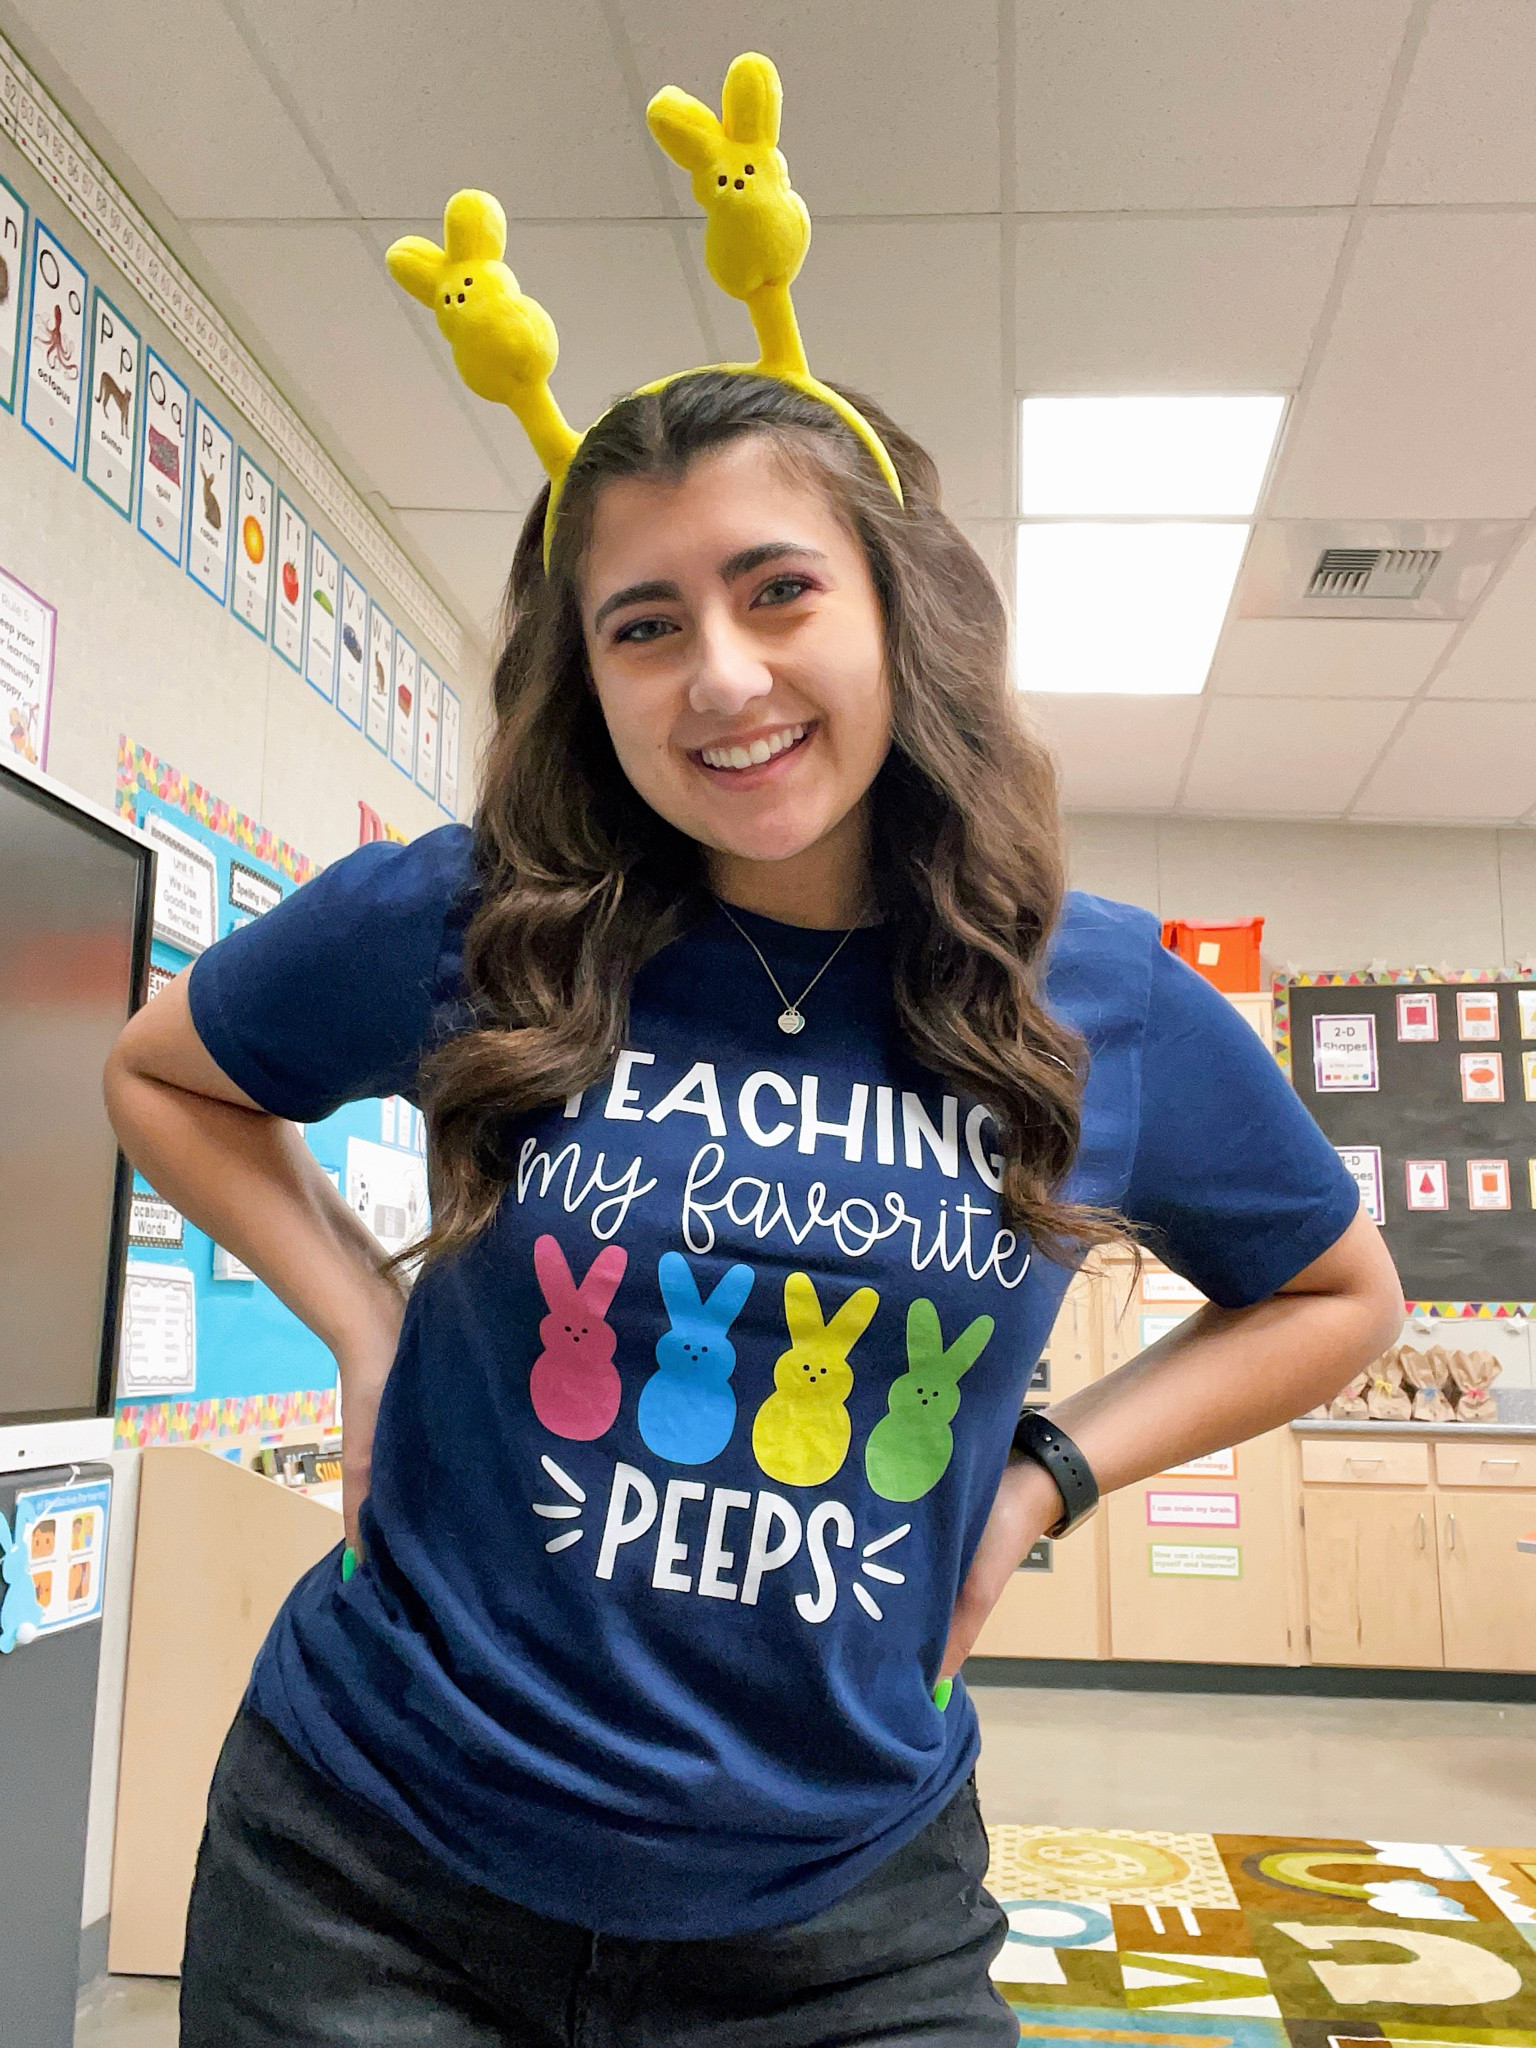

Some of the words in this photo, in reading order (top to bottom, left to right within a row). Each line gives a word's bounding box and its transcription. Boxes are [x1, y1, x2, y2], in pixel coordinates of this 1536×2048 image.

[39, 249, 60, 289] O
[68, 290, 81, 316] o
[101, 313, 114, 344] P
[120, 345, 133, 374] p
[37, 367, 71, 405] octopus
[150, 370, 166, 411] Q
[170, 402, 185, 438] q
[101, 430, 122, 456] puma
[202, 423, 214, 460] R
[219, 452, 226, 471] r
[244, 471, 255, 502] S
[285, 511, 293, 541] T
[314, 547, 325, 578] U
[327, 569, 335, 591] u
[345, 581, 356, 610] V
[17, 629, 36, 648] your
[371, 612, 383, 643] W
[7, 638, 41, 676] learning
[398, 642, 406, 672] X
[423, 672, 430, 695] Y
[1323, 1041, 1368, 1053] Shapes
[1334, 1026, 1356, 1037] 2-D
[137, 1219, 168, 1236] Words
[517, 1137, 658, 1241] my
[681, 1142, 1031, 1290] favorite
[595, 1461, 855, 1624] PEEPS
